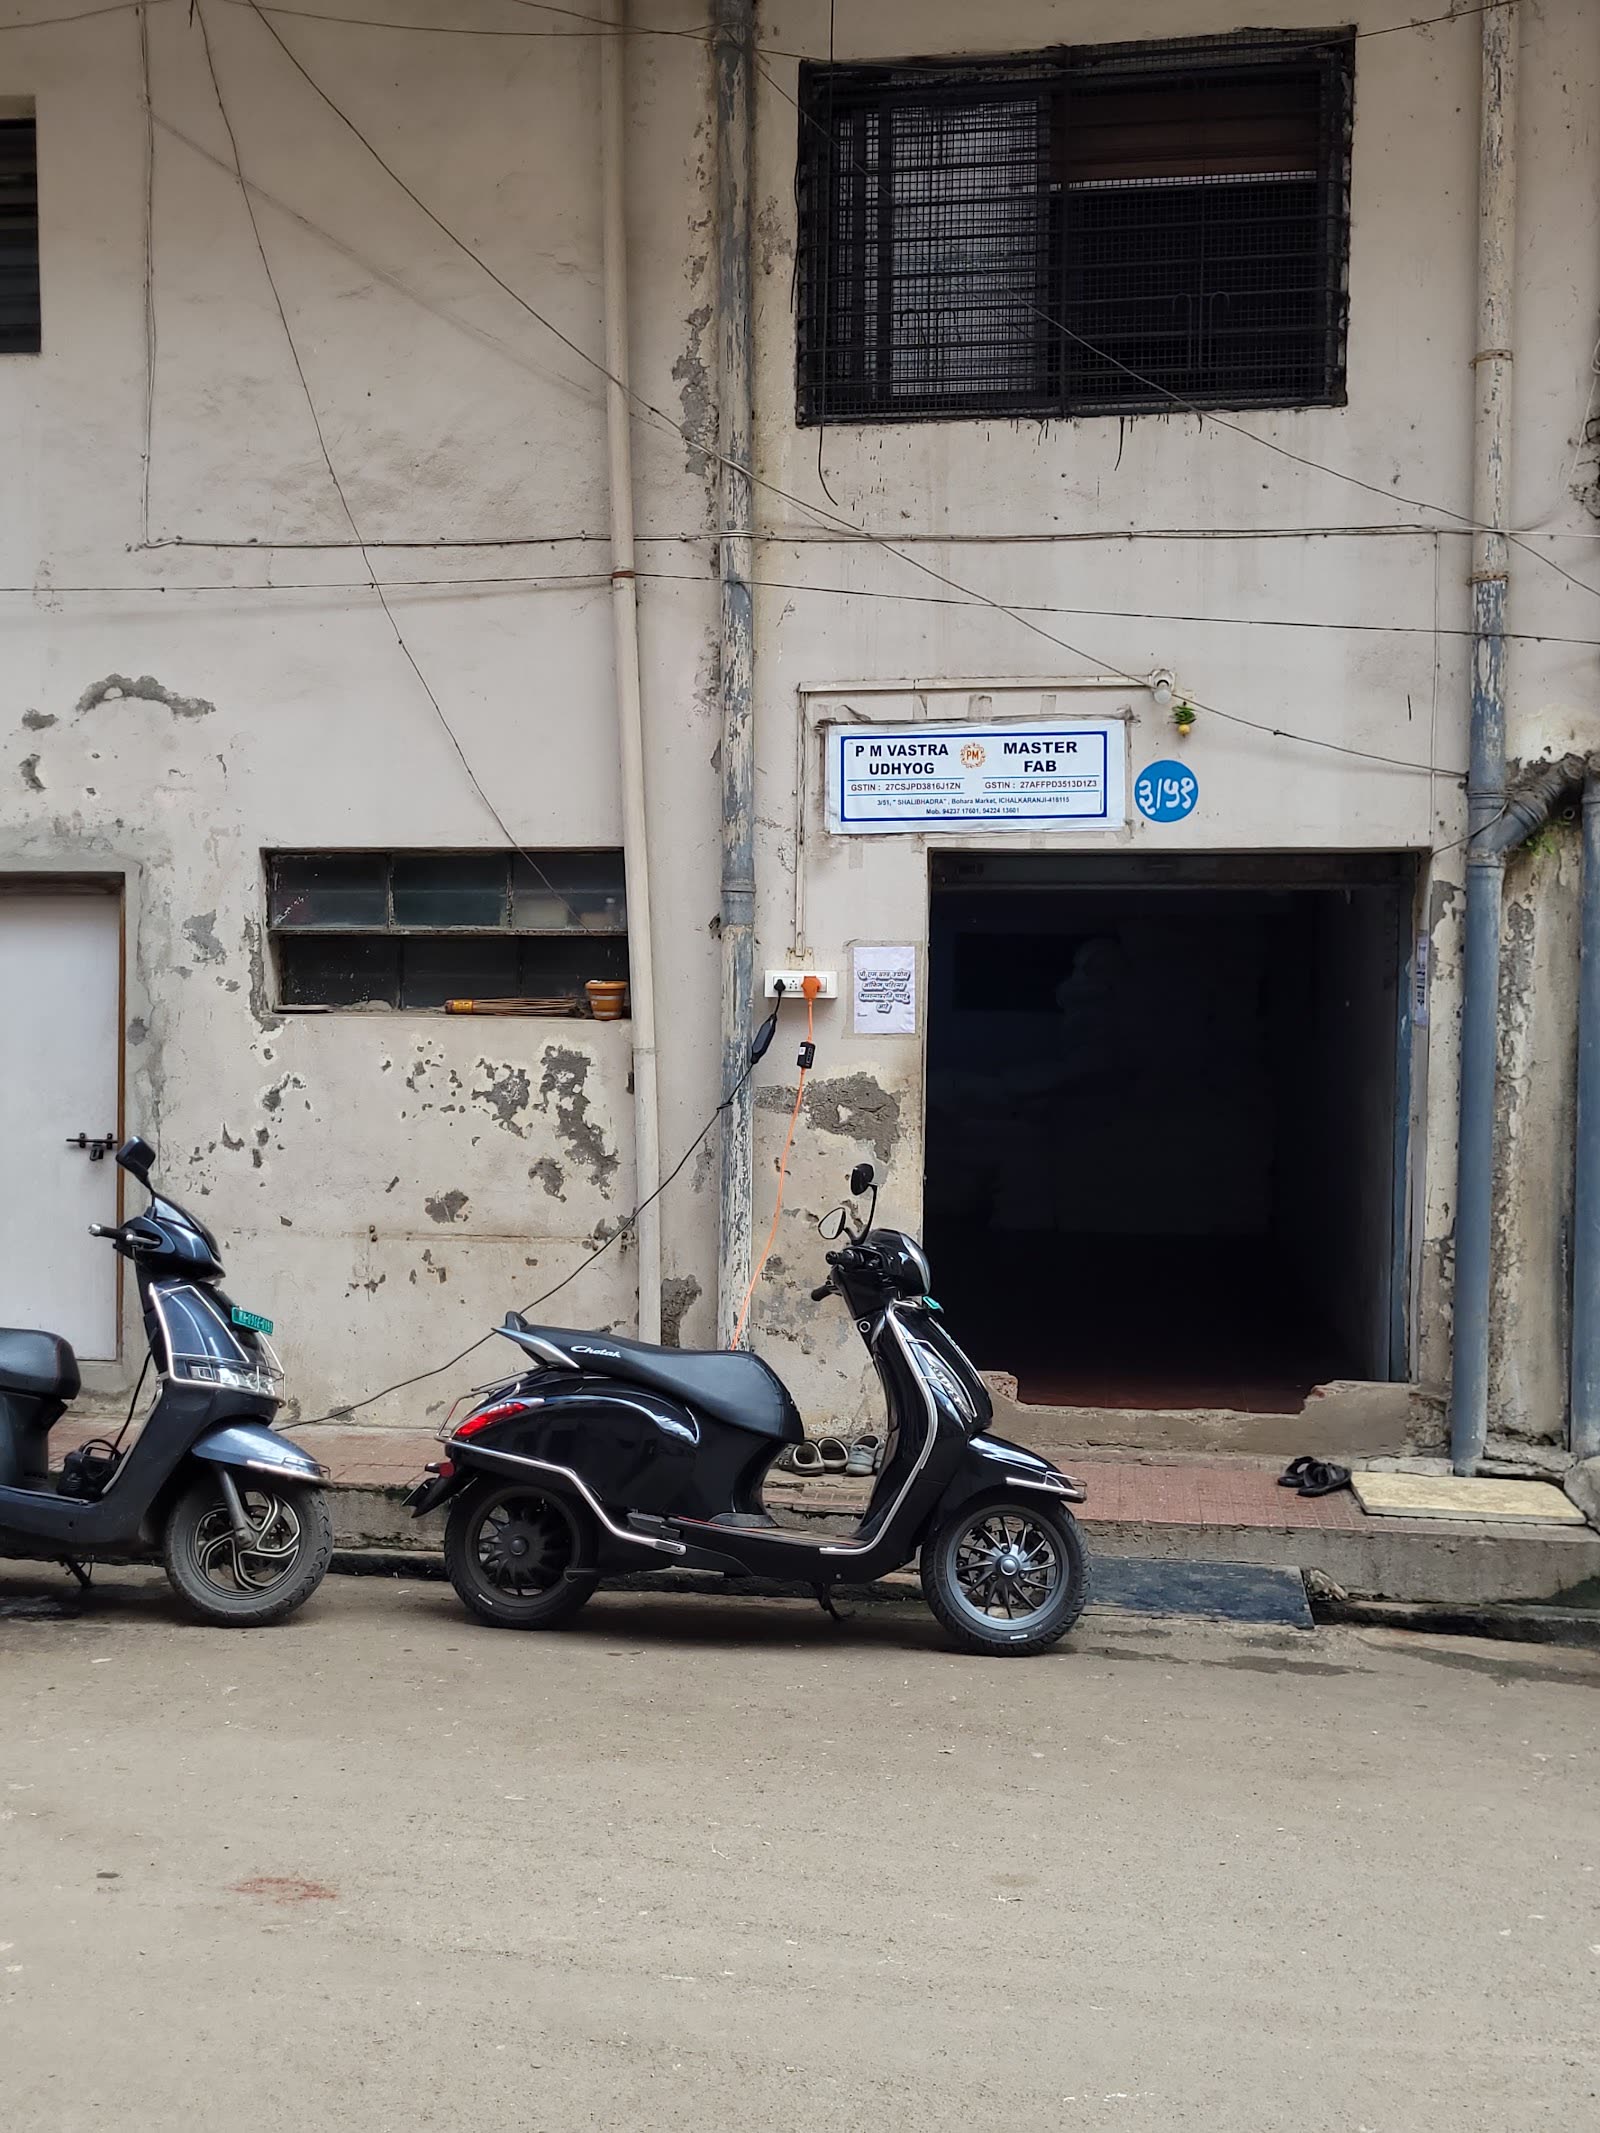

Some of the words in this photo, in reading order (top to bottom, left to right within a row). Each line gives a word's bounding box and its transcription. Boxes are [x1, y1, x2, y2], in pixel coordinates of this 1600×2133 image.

[855, 745, 865, 757] P
[869, 745, 882, 757] M
[887, 744, 949, 756] VASTRA
[1003, 741, 1078, 754] MASTER
[966, 750, 979, 760] PM
[869, 762, 935, 775] UDHYOG
[1023, 760, 1057, 773] FAB
